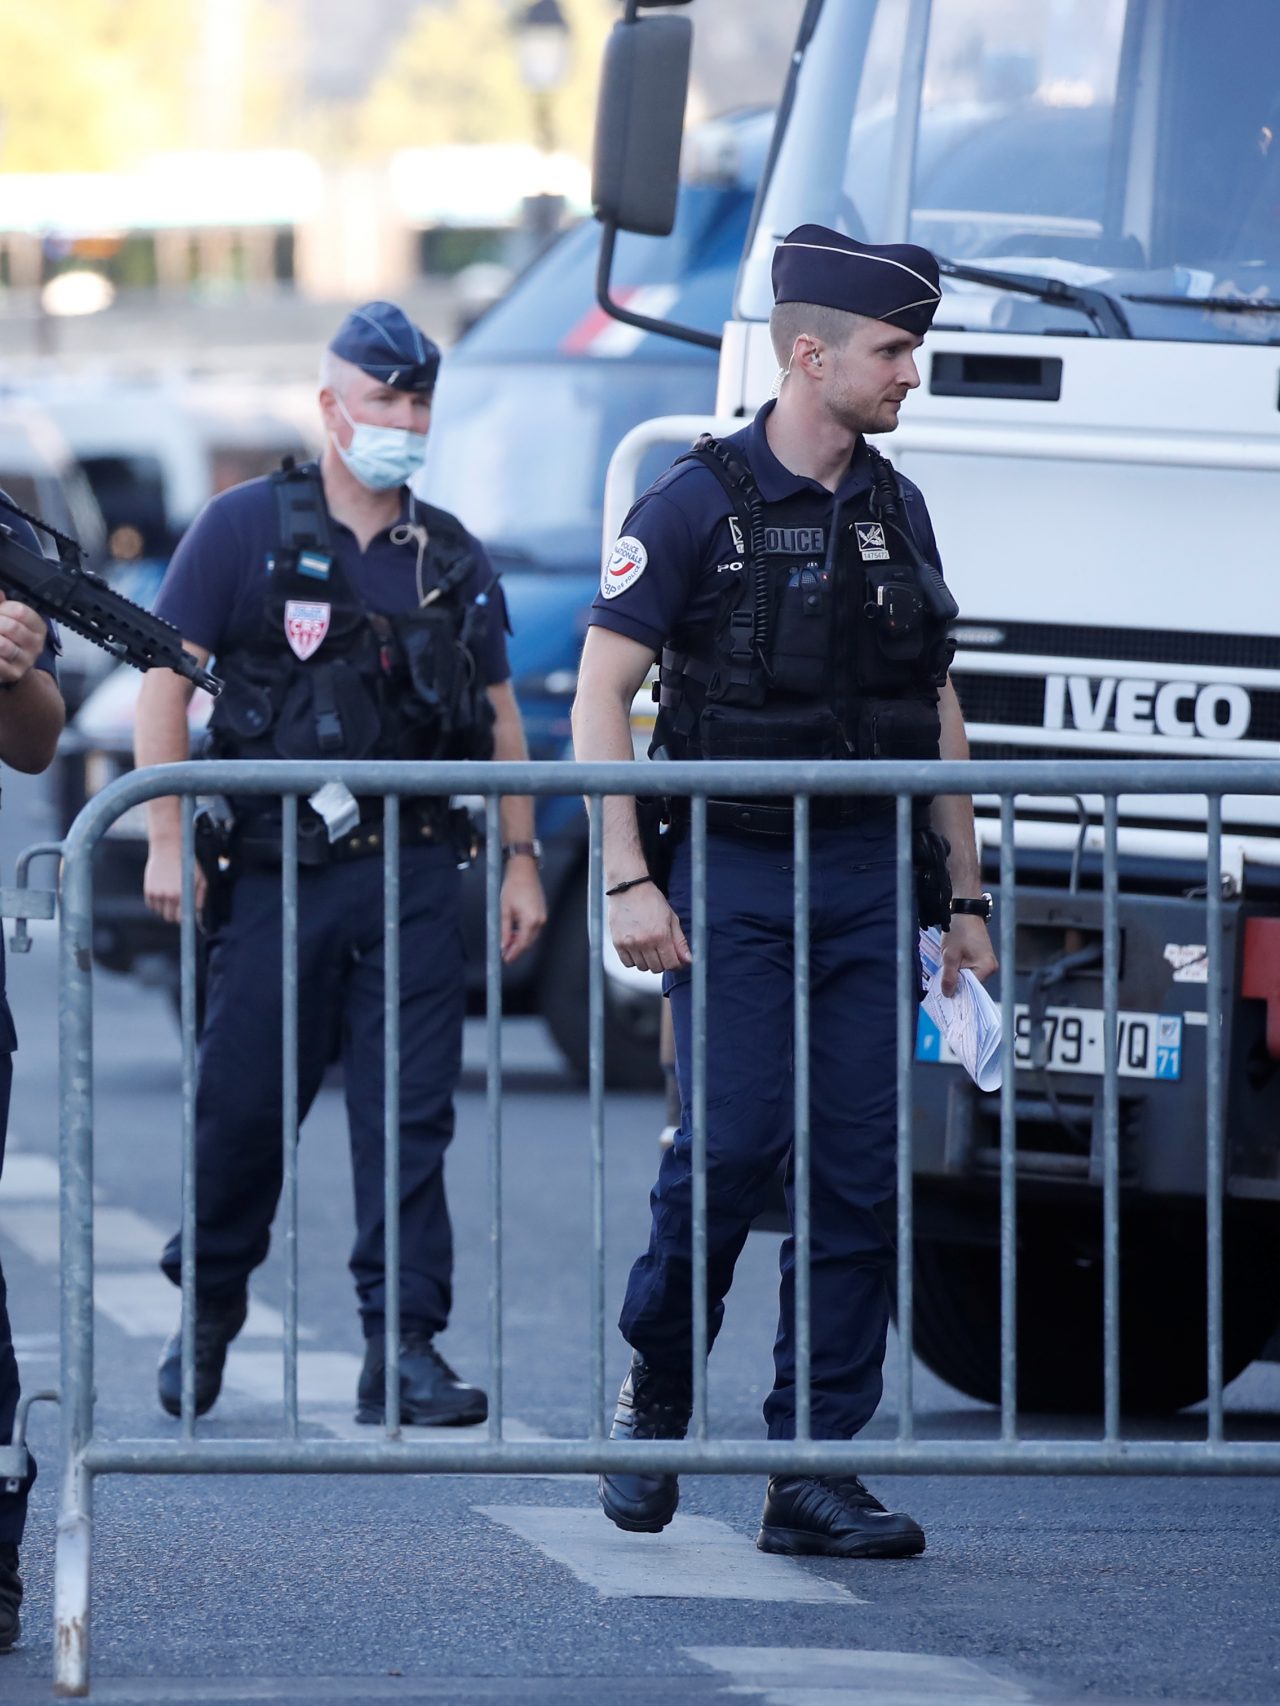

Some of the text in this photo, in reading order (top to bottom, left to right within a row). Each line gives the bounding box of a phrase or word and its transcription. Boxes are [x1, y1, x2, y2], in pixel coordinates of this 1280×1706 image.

[621, 541, 639, 554] POLICE
[756, 528, 823, 552] OLICE
[1043, 674, 1251, 739] IVECO
[1157, 1048, 1179, 1074] 71
